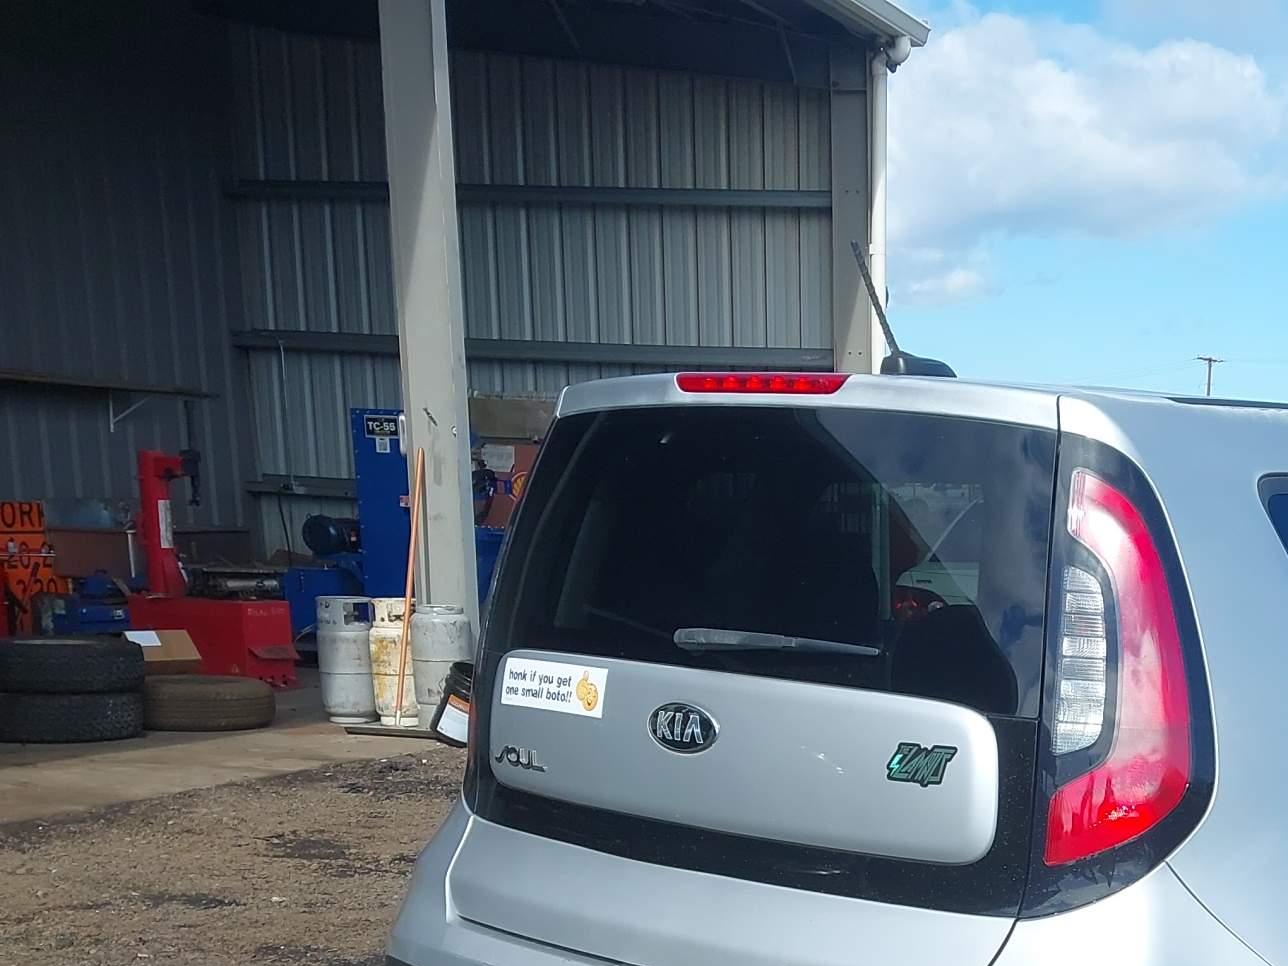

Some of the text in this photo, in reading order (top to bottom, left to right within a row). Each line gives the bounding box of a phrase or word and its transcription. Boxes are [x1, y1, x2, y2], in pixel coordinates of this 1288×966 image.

[367, 421, 396, 431] TC-55
[508, 668, 572, 688] honk if you get
[505, 685, 573, 703] one small boto!!
[656, 711, 704, 744] KIA
[495, 745, 547, 772] SOUL
